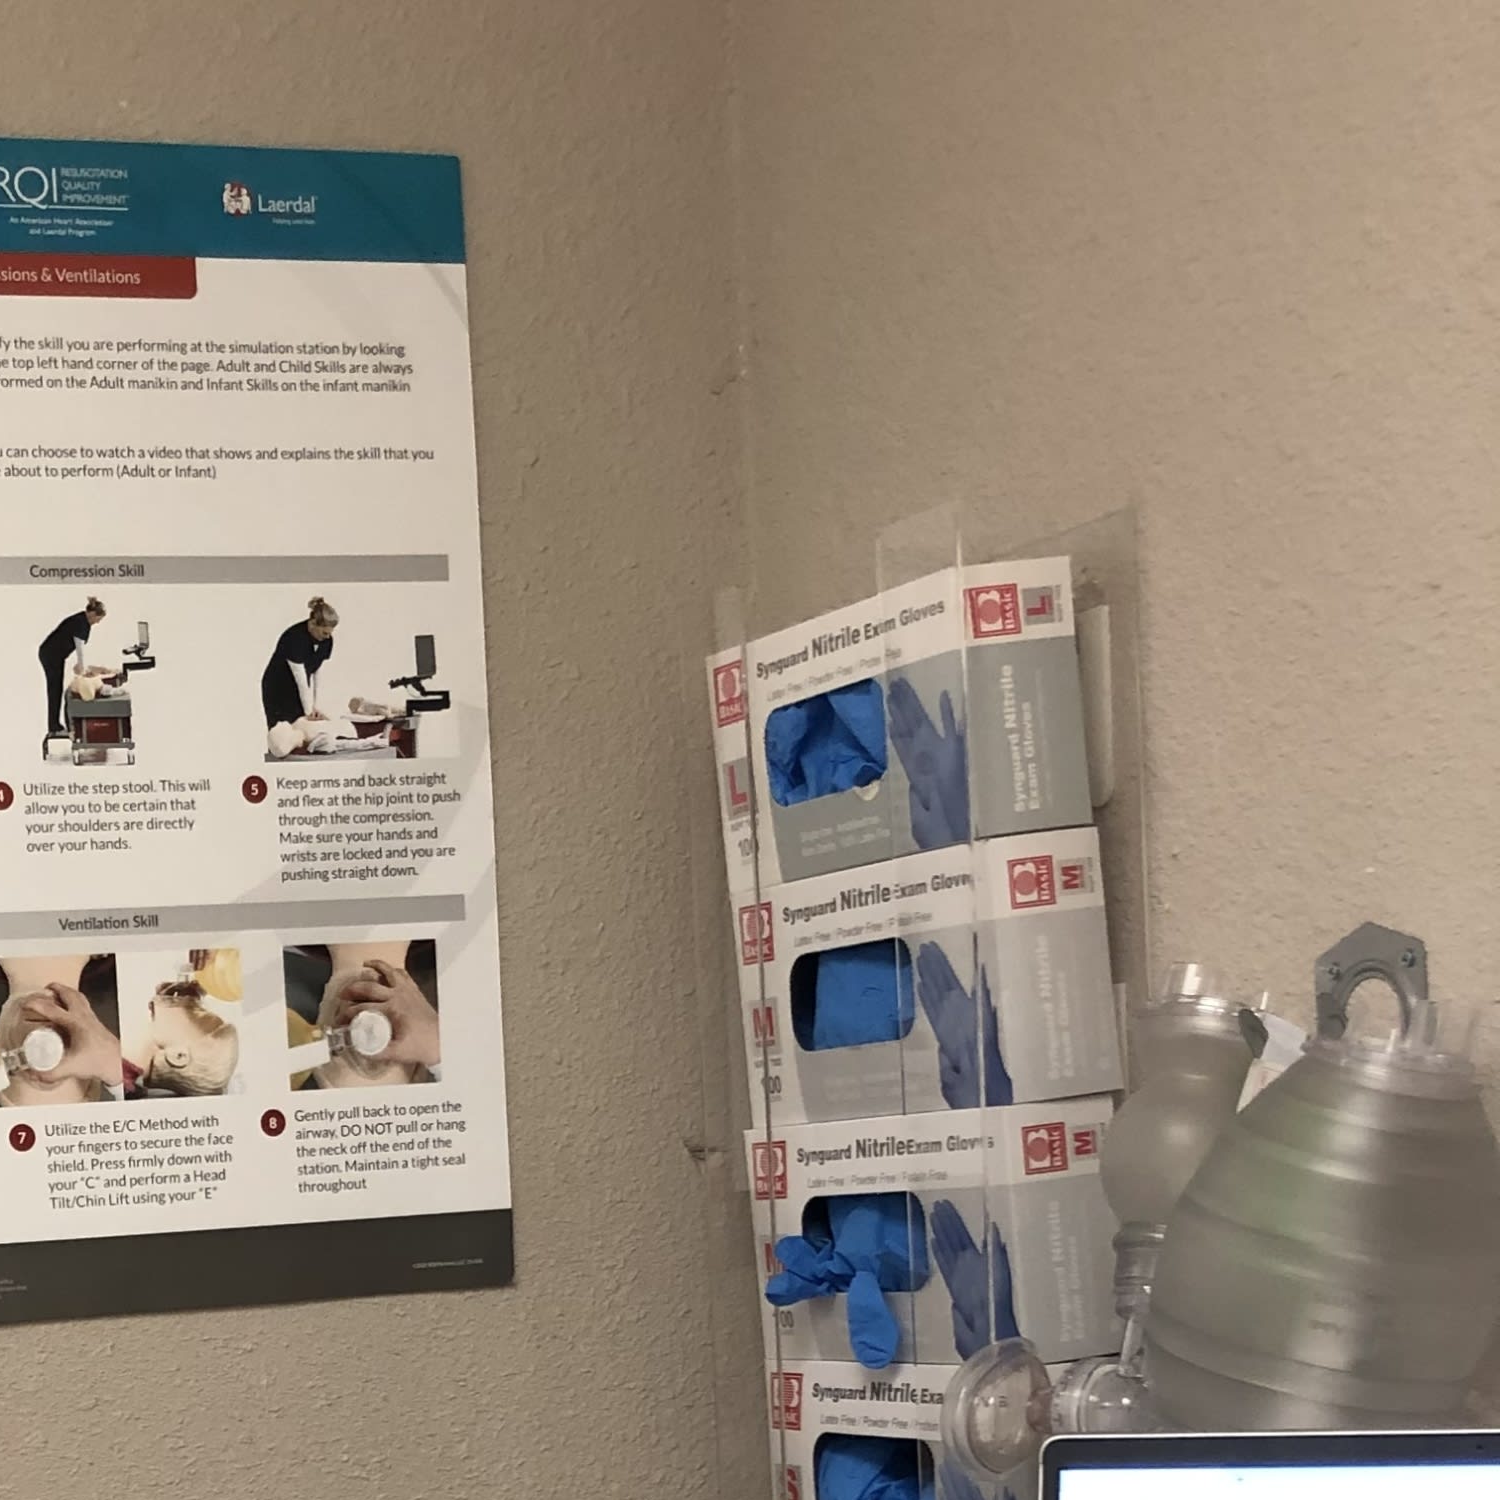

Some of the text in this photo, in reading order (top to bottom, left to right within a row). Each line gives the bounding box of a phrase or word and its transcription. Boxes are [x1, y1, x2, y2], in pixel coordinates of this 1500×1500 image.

[40, 266, 53, 282] &
[54, 267, 141, 285] Ventilations
[5, 447, 29, 458] can
[30, 444, 78, 459] choose
[79, 446, 94, 459] to
[95, 445, 136, 459] watch
[137, 448, 146, 459] a
[146, 445, 183, 460] video
[184, 446, 211, 460] that
[212, 446, 253, 460] shows
[254, 446, 279, 460] and
[279, 446, 332, 462] explains
[332, 446, 355, 461] the
[355, 446, 382, 461] skill
[382, 446, 411, 461] that
[410, 449, 435, 462] you
[3, 463, 42, 478] about
[44, 465, 59, 478] to
[60, 463, 114, 480] perform
[115, 463, 157, 480] (Adult
[157, 467, 173, 479] or
[174, 464, 217, 480] Infant)
[28, 563, 145, 580] Compression Skill
[756, 647, 809, 679] Synguard
[811, 624, 861, 658] Nitrile
[900, 600, 945, 627] Gloves
[782, 900, 837, 924] Synguard
[840, 884, 891, 911] Nitrile
[57, 913, 159, 931] Ventilation Skill
[796, 1145, 852, 1166] Synguard
[855, 1136, 905, 1158] Nitrile
[906, 1138, 942, 1155] Exam
[811, 1382, 866, 1402] Synguard
[919, 1388, 944, 1405] Exa
